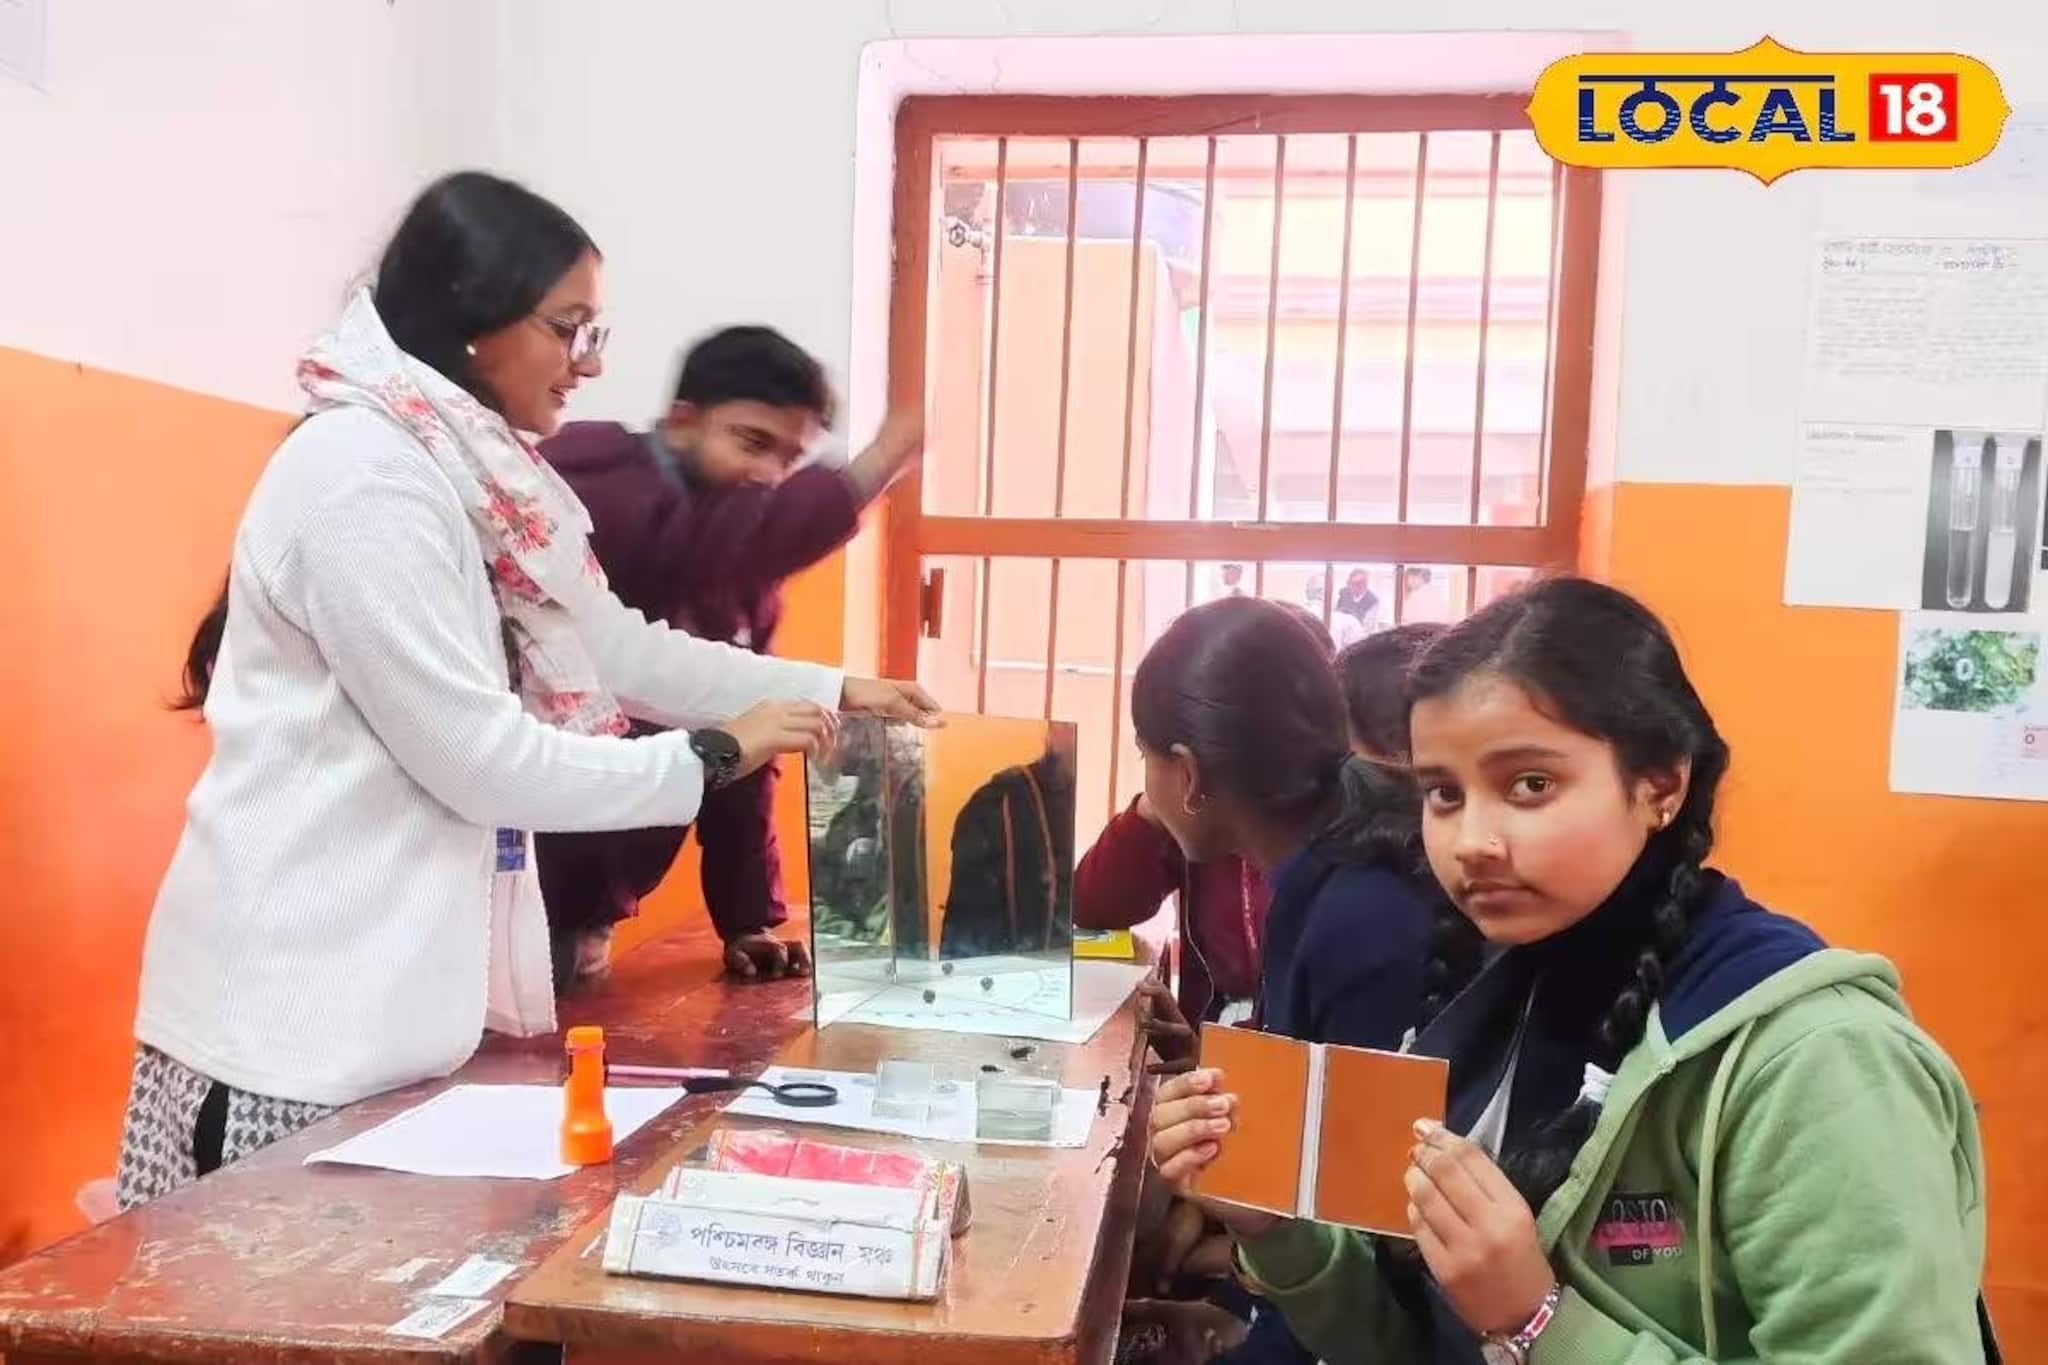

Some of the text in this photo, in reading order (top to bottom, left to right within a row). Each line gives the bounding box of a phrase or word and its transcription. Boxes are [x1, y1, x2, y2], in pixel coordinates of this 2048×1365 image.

[690, 1222, 779, 1255] পশ্চিমবঙ্গ
[785, 1231, 846, 1264] বিজ্ঞান
[1631, 1248, 1649, 1261] OF
